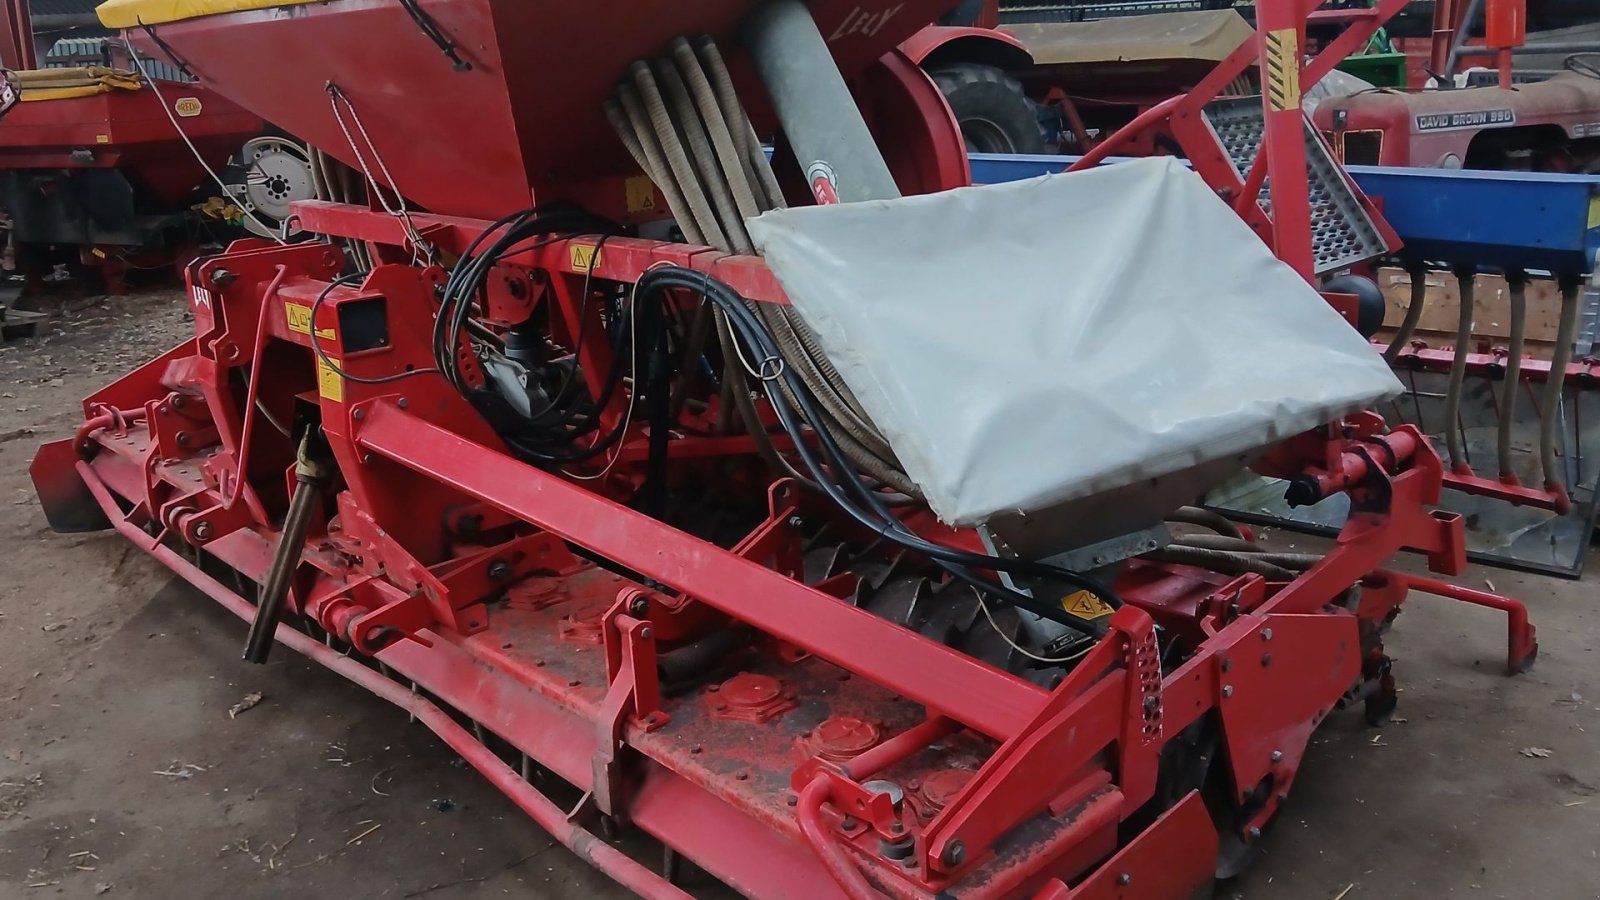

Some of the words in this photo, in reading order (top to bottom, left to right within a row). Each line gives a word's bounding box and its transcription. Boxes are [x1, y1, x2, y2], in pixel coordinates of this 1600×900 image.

[828, 3, 904, 41] LELY
[1420, 115, 1448, 129] DAVID
[1453, 112, 1486, 125] BROWN
[1490, 110, 1511, 122] 990
